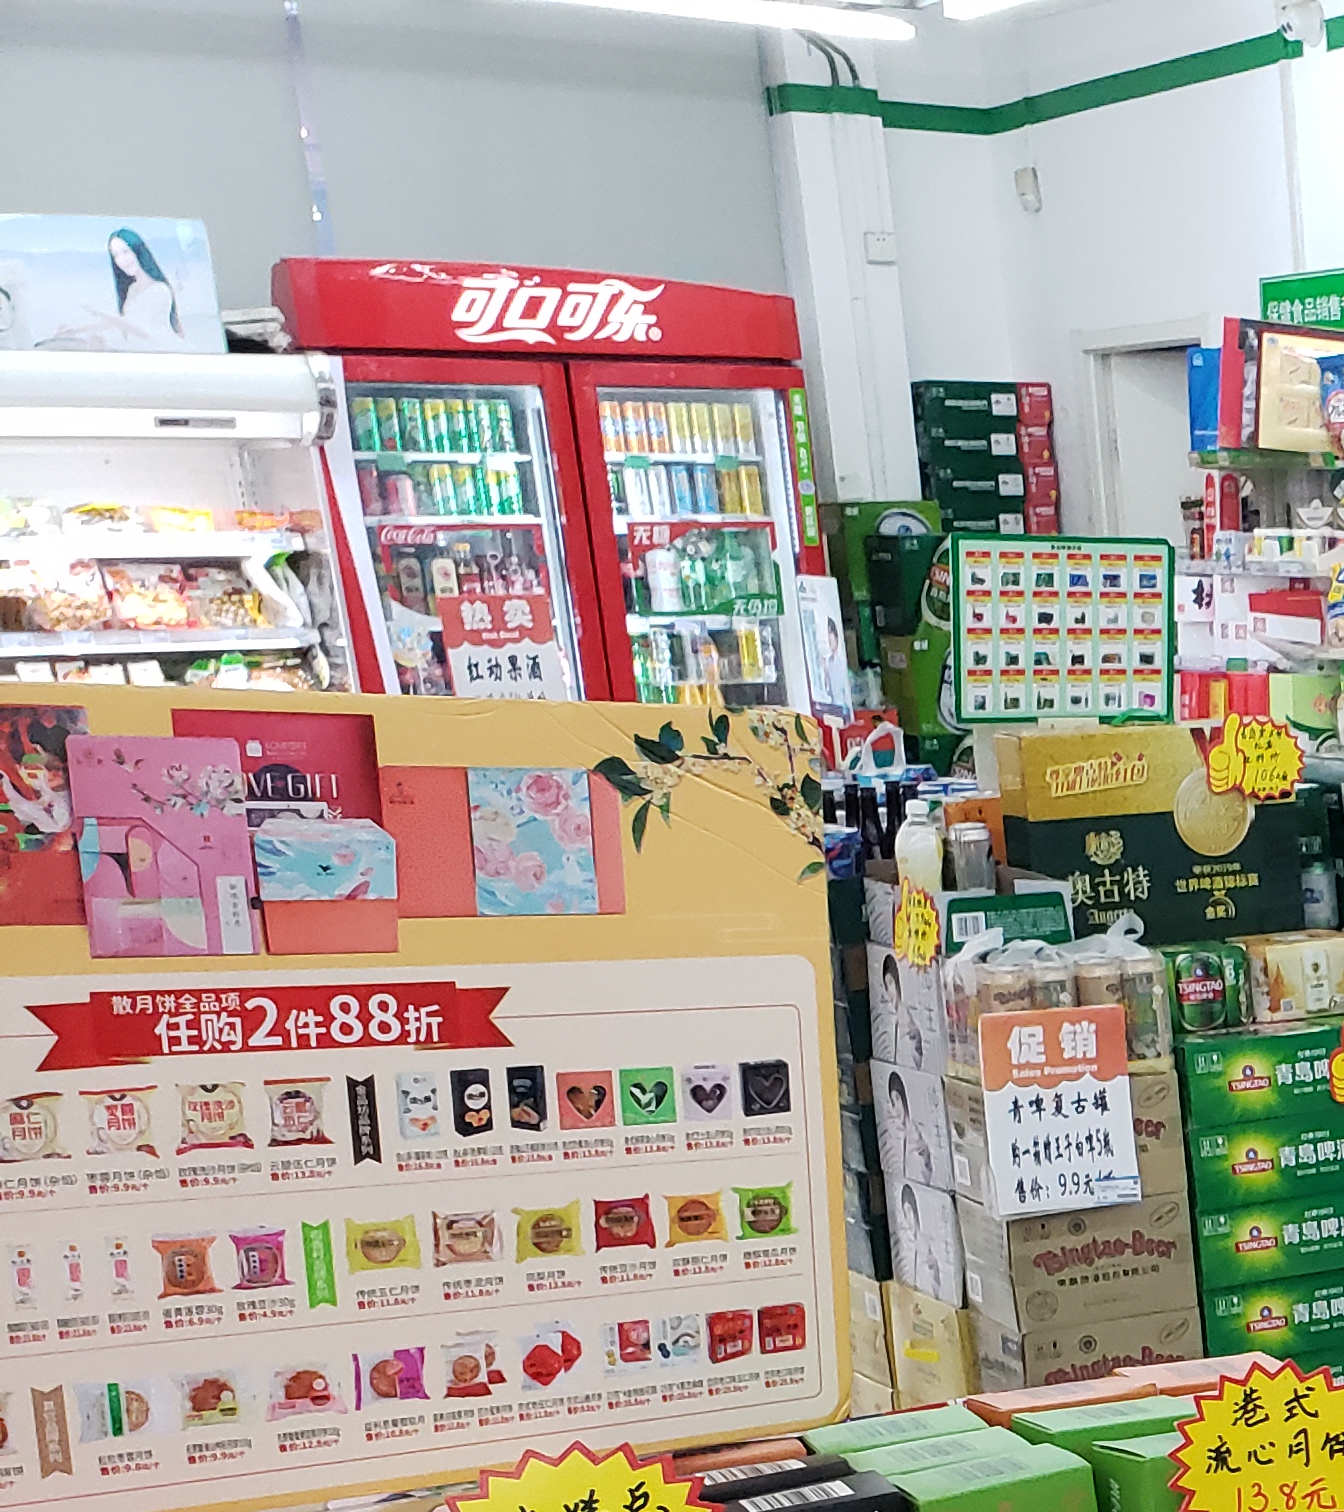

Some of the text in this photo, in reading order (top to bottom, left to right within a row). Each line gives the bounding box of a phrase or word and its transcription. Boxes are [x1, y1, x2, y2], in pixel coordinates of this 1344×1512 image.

[450, 277, 666, 344] 可口可乐
[1068, 863, 1152, 908] 奥古特
[110, 992, 242, 1016] 散月饼全品项
[154, 993, 443, 1054] 任购2件88折
[1006, 1021, 1097, 1065] 促销
[1275, 1058, 1331, 1087] 青岛啤
[1230, 1385, 1320, 1429] 港式
